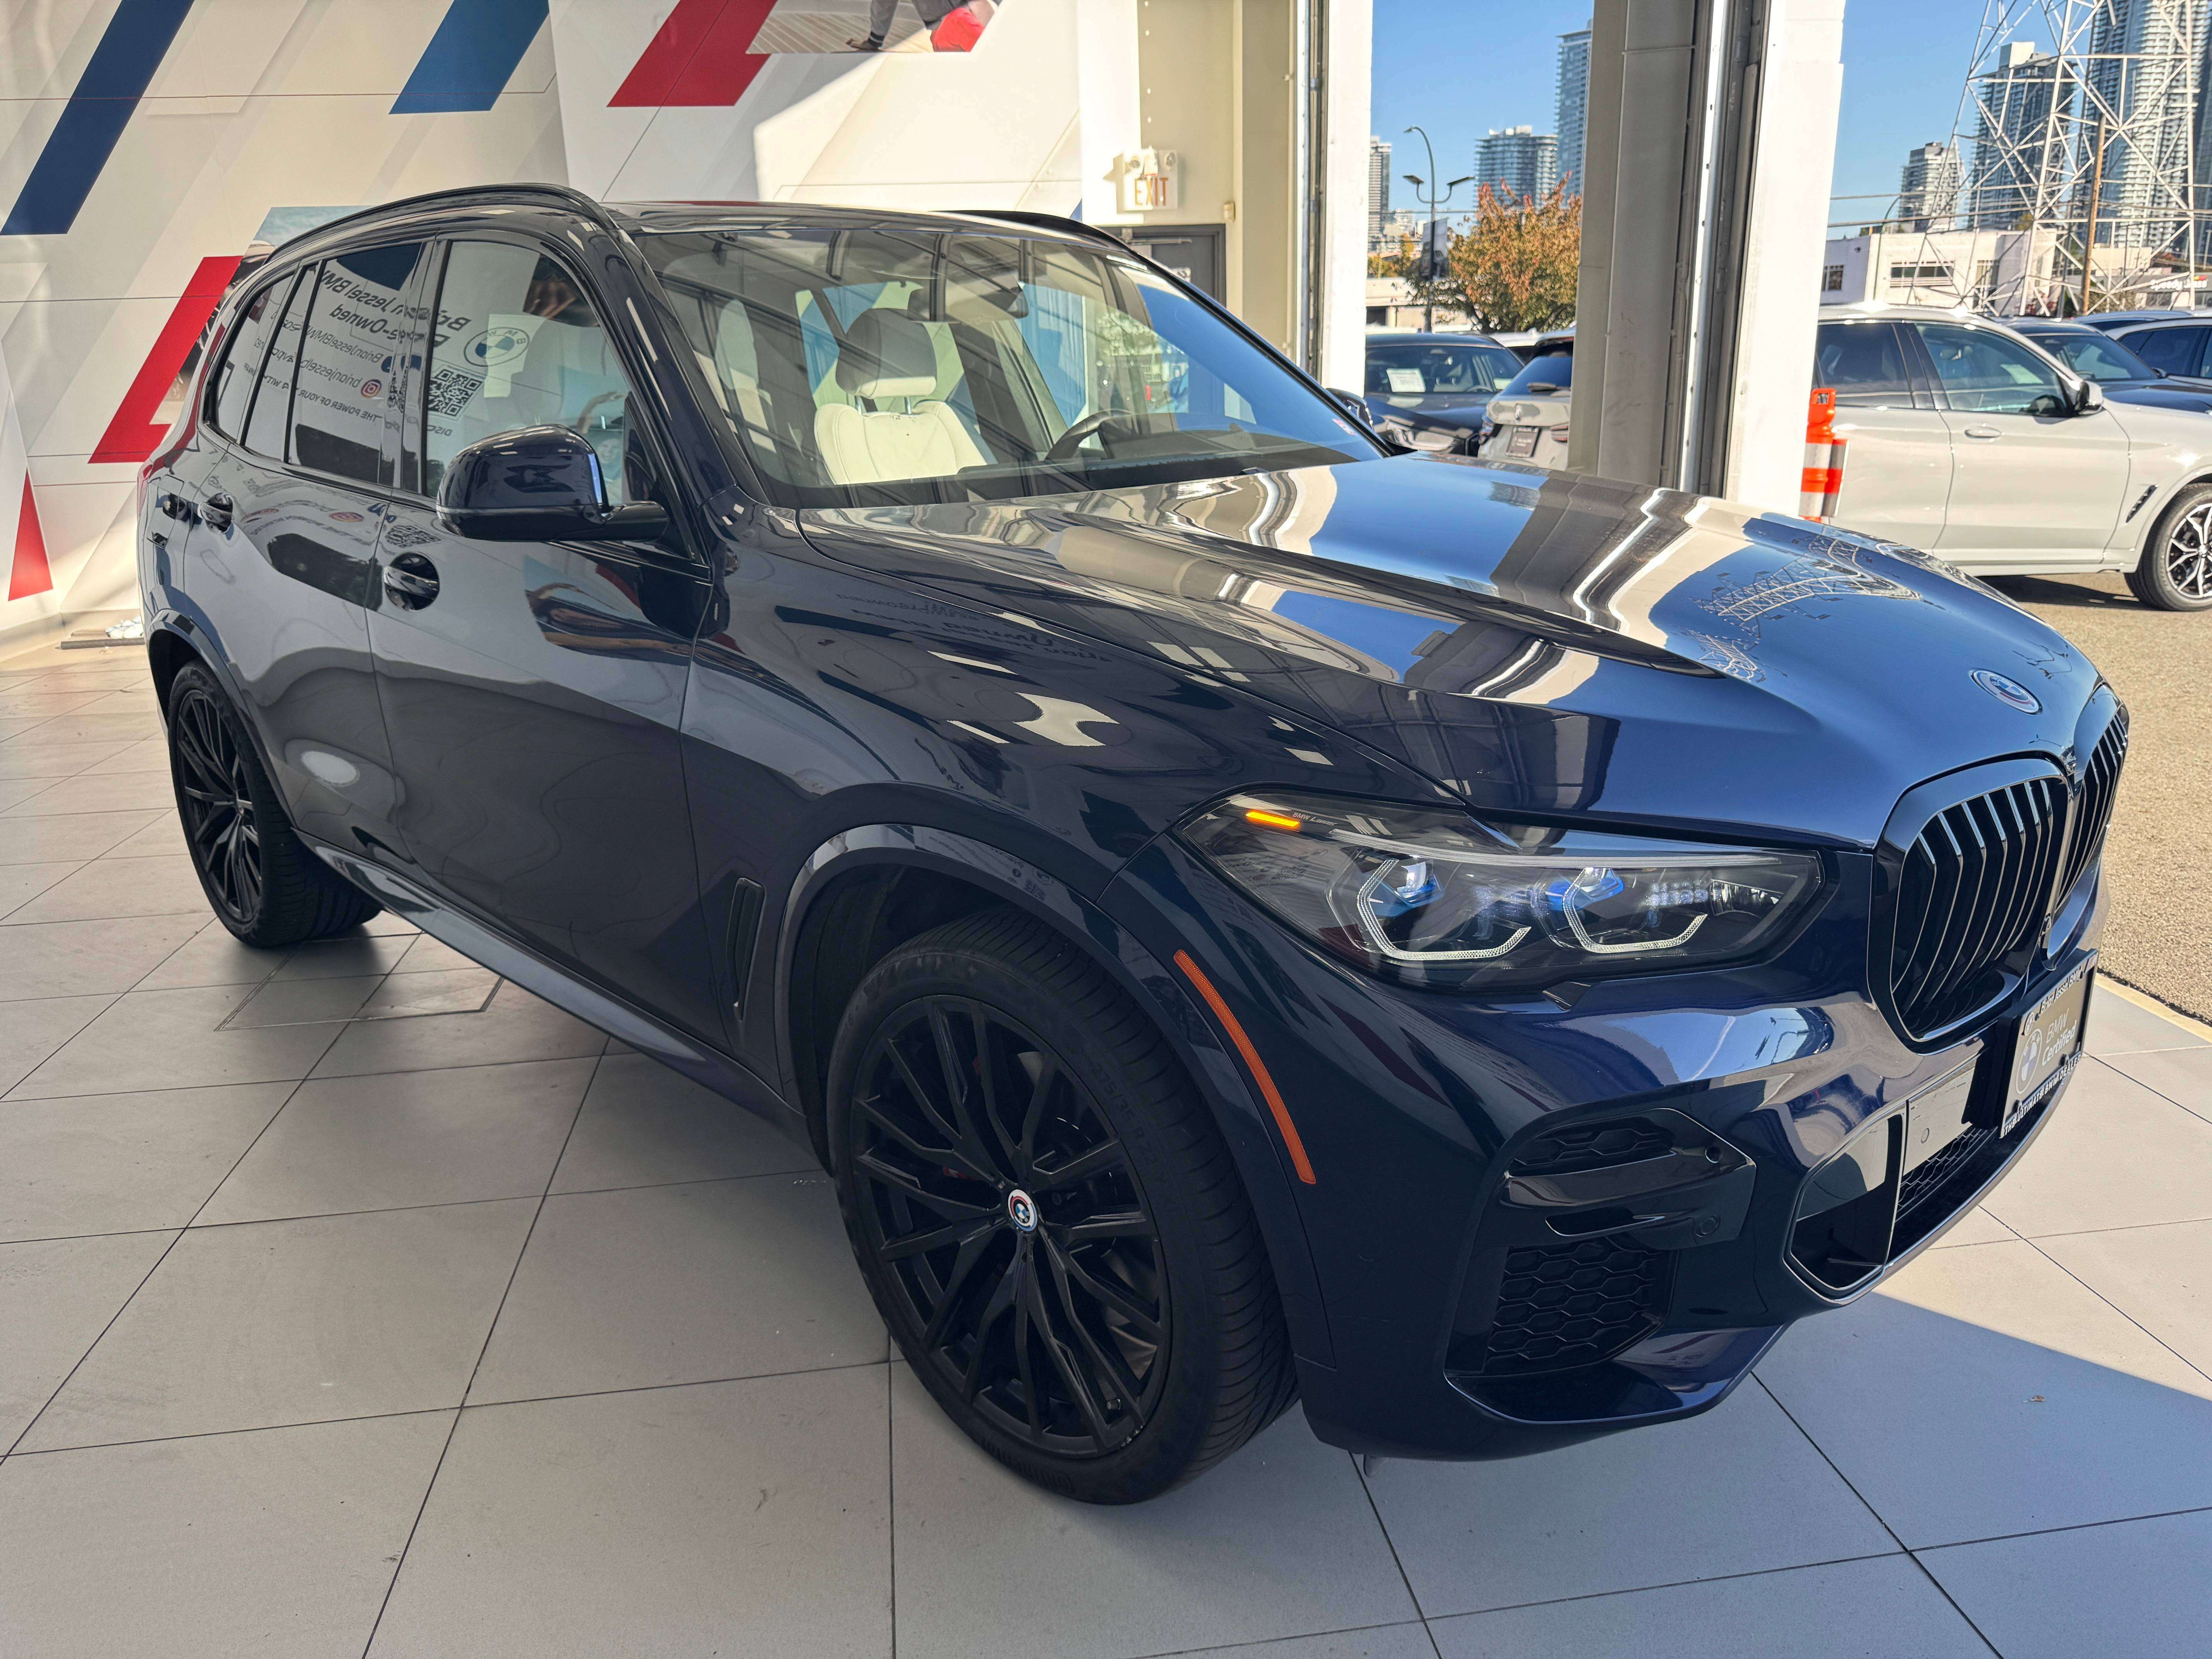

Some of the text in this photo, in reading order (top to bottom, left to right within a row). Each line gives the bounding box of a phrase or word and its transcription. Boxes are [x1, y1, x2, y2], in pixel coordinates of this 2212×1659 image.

[1134, 177, 1168, 207] EXIT
[1292, 812, 1338, 826] BMW Laser
[2042, 1019, 2077, 1066] Certified
[2046, 1008, 2069, 1044] BMW
